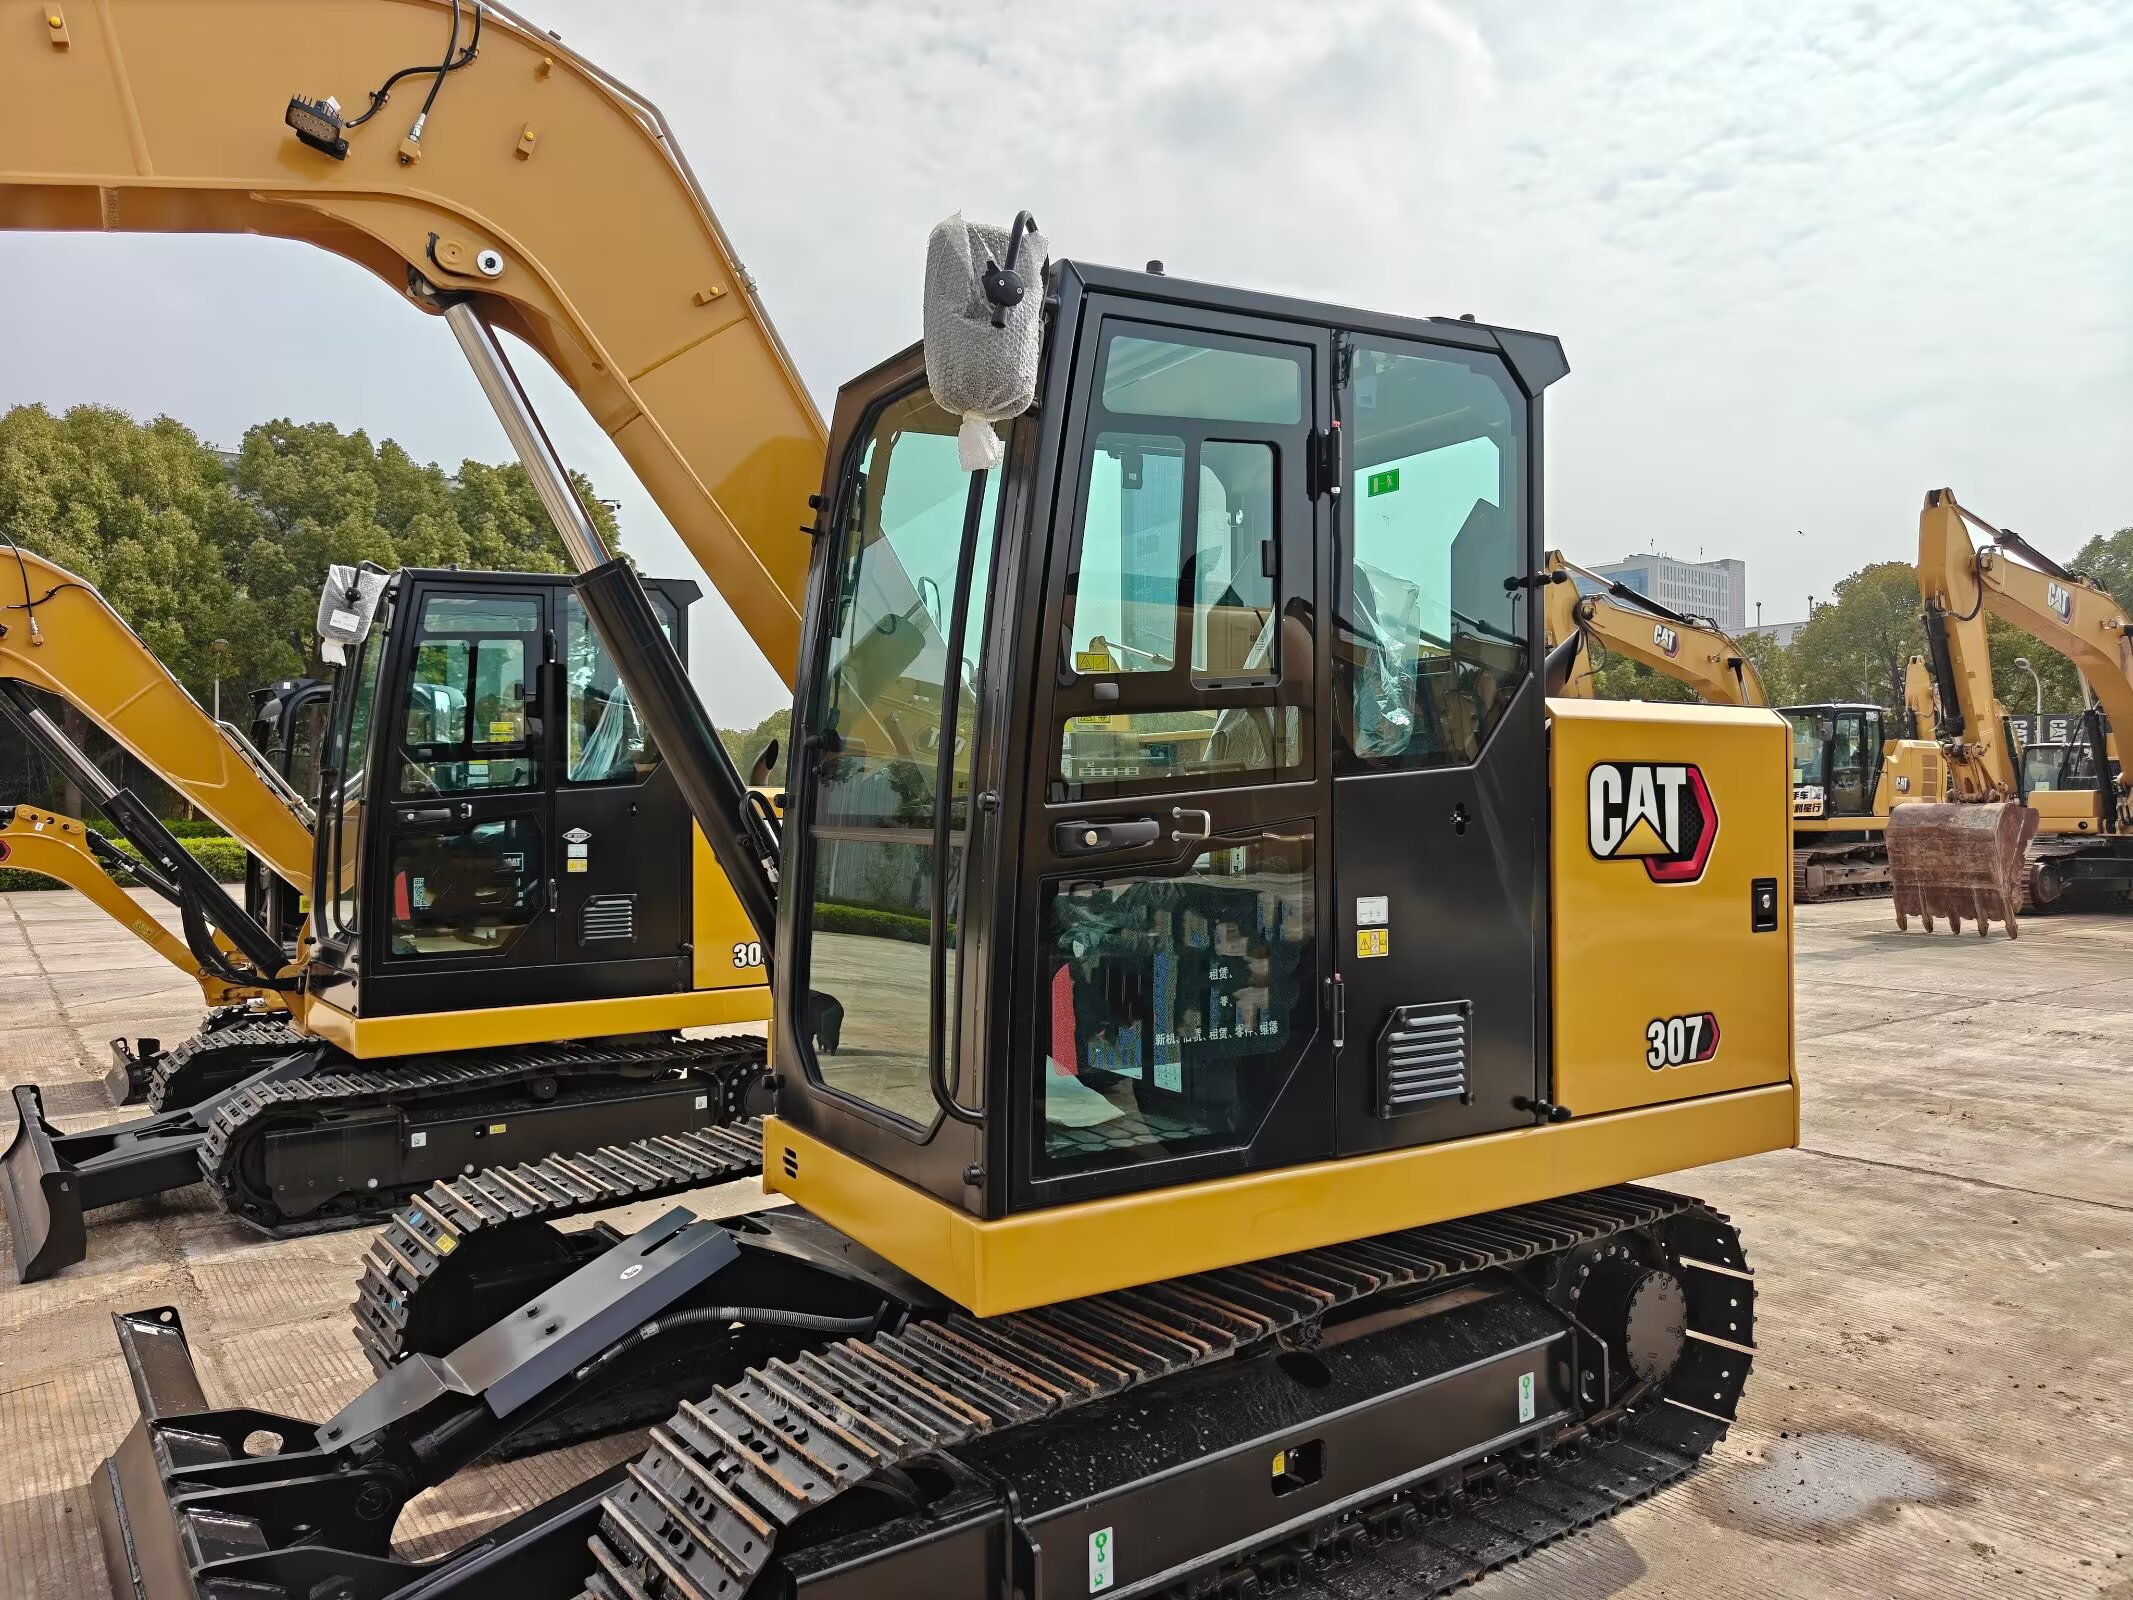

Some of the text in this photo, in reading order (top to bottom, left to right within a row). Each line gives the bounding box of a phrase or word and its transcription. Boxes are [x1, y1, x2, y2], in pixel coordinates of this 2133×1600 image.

[2048, 582, 2070, 614] CAT
[1654, 623, 1676, 651] CAT
[2049, 719, 2067, 743] CAT
[1896, 776, 1908, 791] CAT
[1589, 764, 1687, 856] CAT
[733, 942, 765, 967] 30
[1647, 1015, 1703, 1067] 307
